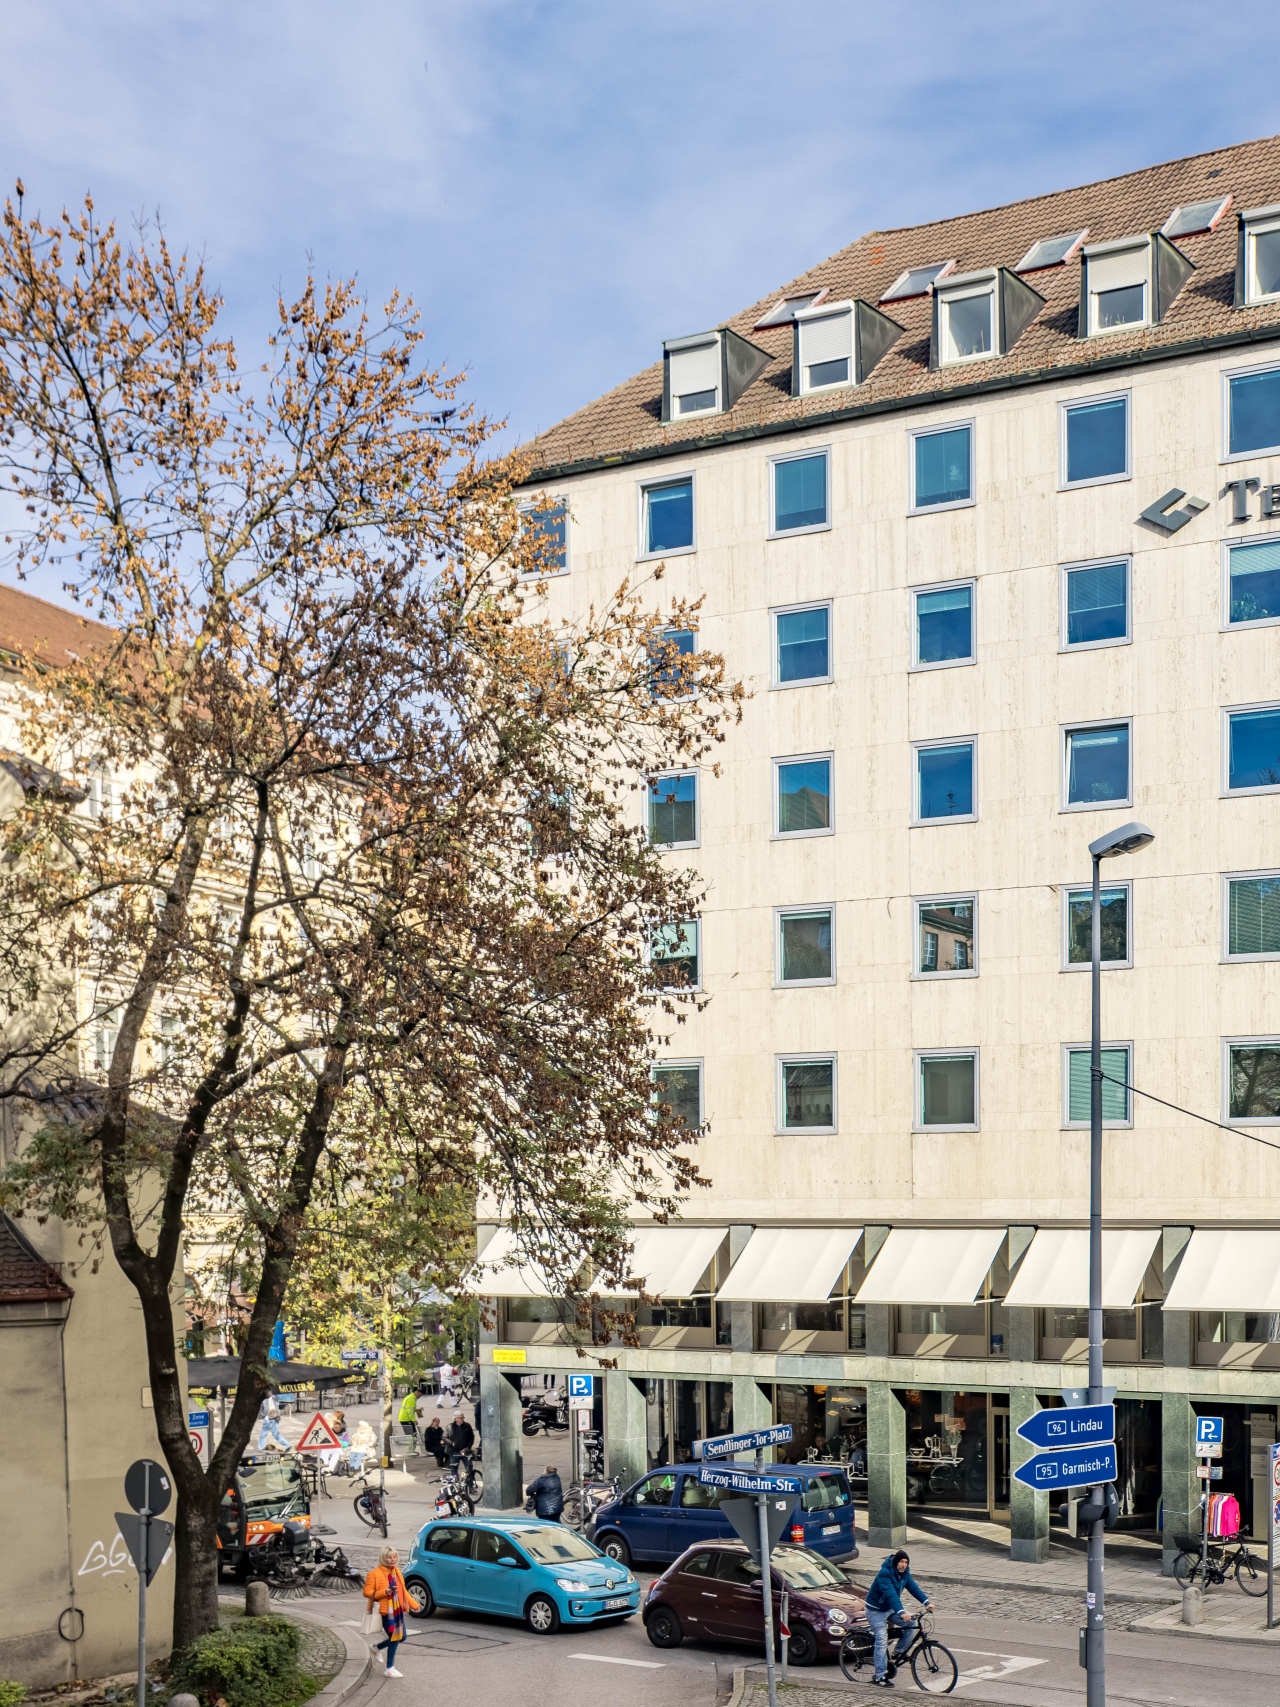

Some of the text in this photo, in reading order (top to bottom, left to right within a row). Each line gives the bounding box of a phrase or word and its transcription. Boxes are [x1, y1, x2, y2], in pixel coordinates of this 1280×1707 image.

[573, 1377, 586, 1395] P
[1052, 1419, 1103, 1433] 96 Lindau
[1201, 1420, 1216, 1440] P
[707, 1429, 791, 1456] Sendlinger-Tor-Platz
[1041, 1456, 1113, 1476] 95 Garmisch-P.
[700, 1470, 795, 1492] Herzog-Wilhelm-Str.
